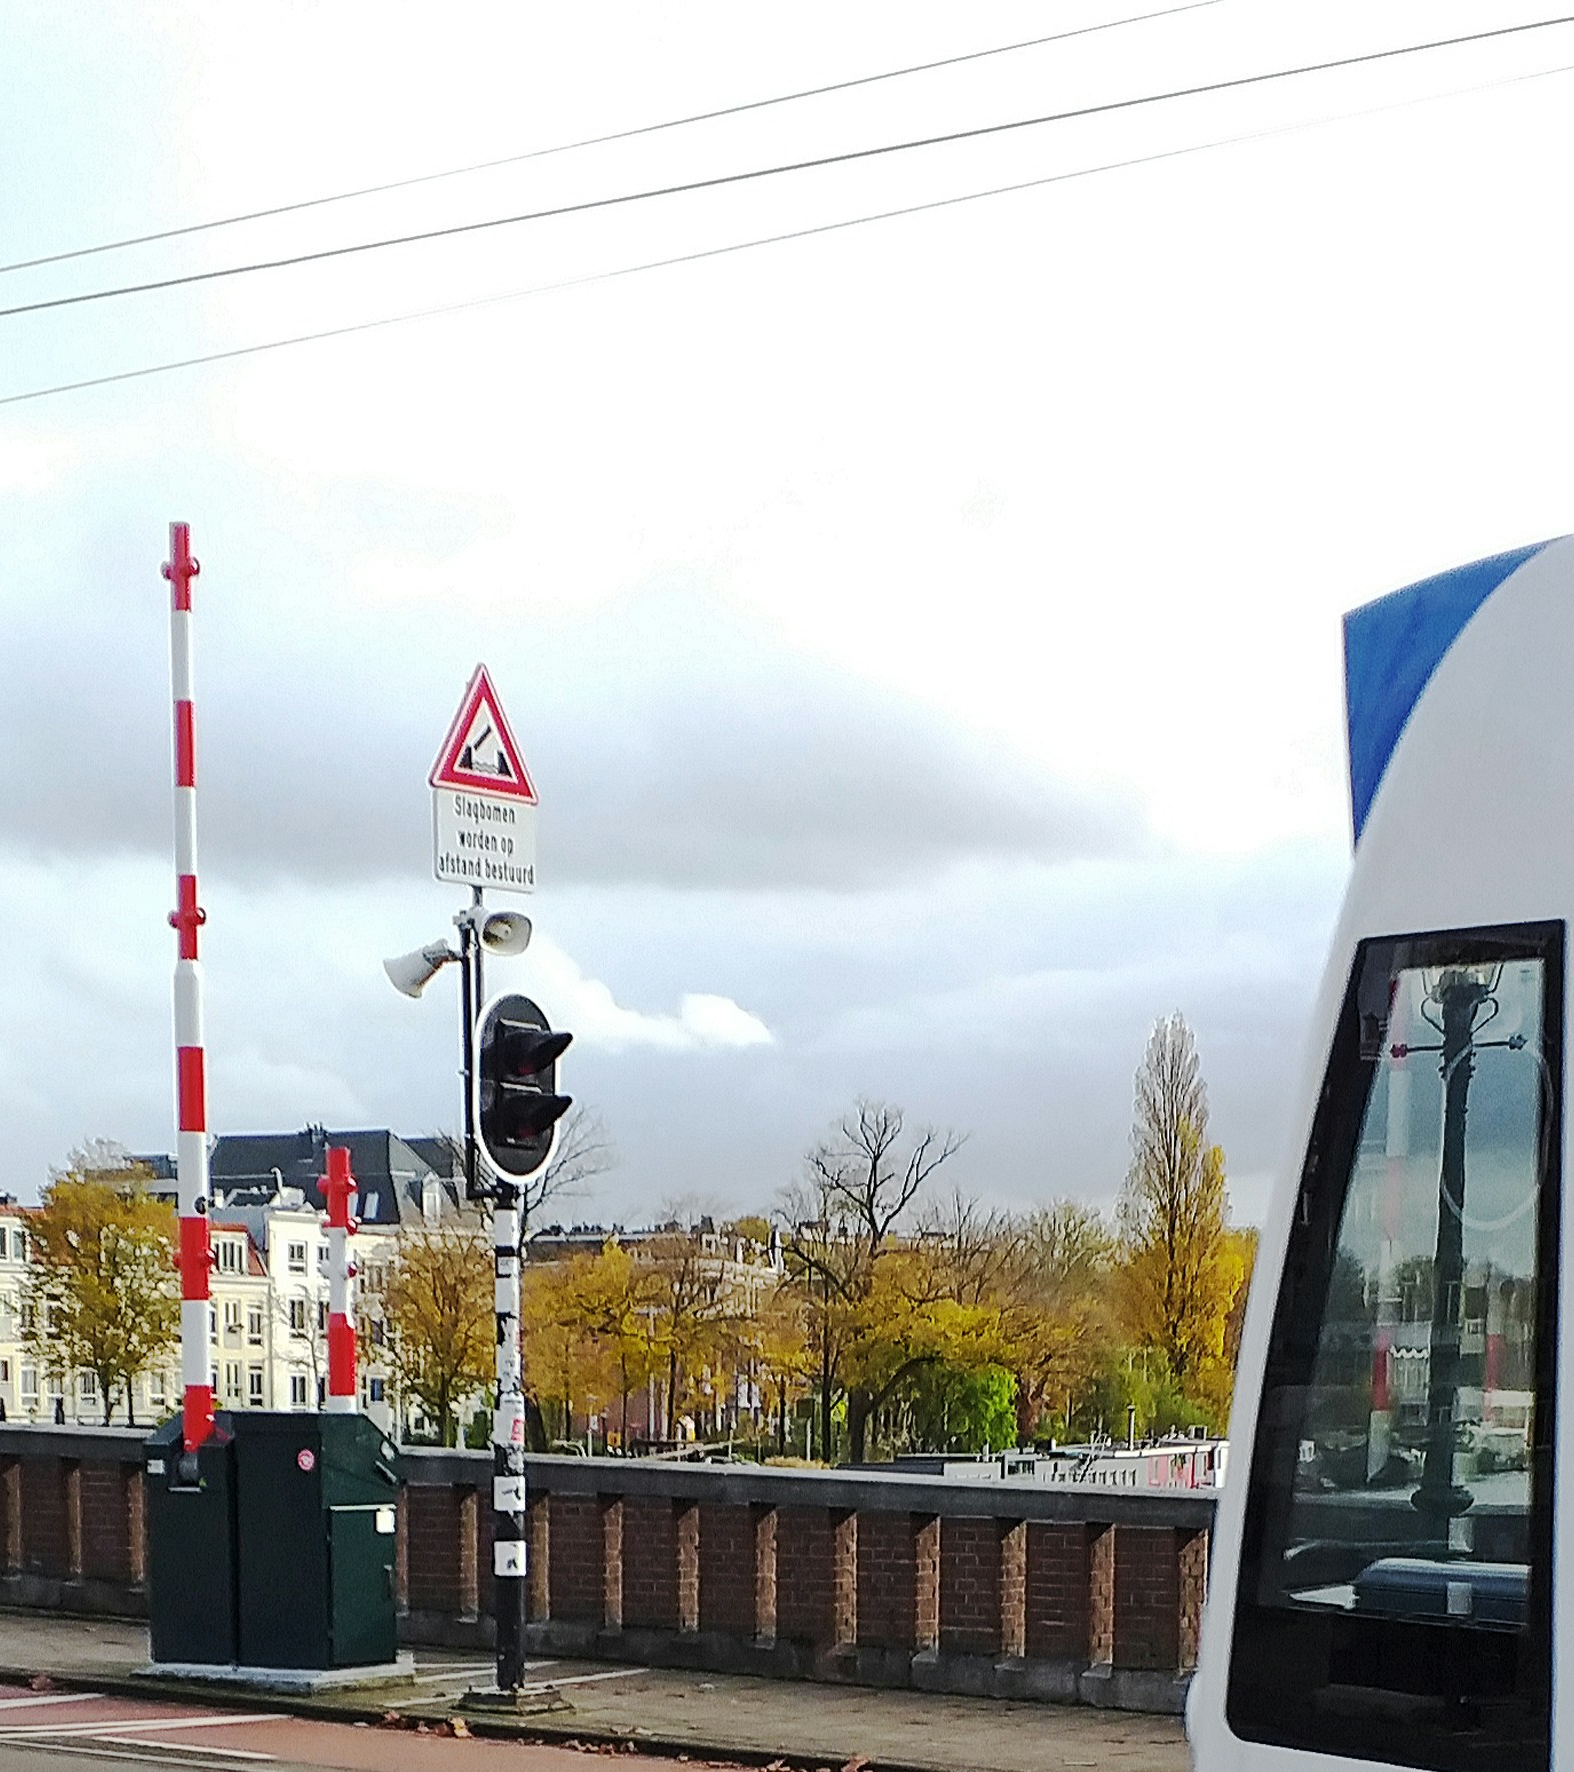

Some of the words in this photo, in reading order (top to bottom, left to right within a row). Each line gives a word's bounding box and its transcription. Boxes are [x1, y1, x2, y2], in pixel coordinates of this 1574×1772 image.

[454, 794, 516, 824] Slagbomen
[458, 829, 498, 852] worden
[500, 835, 514, 857] op
[439, 851, 482, 878] afstand
[485, 858, 534, 885] bestuurd
